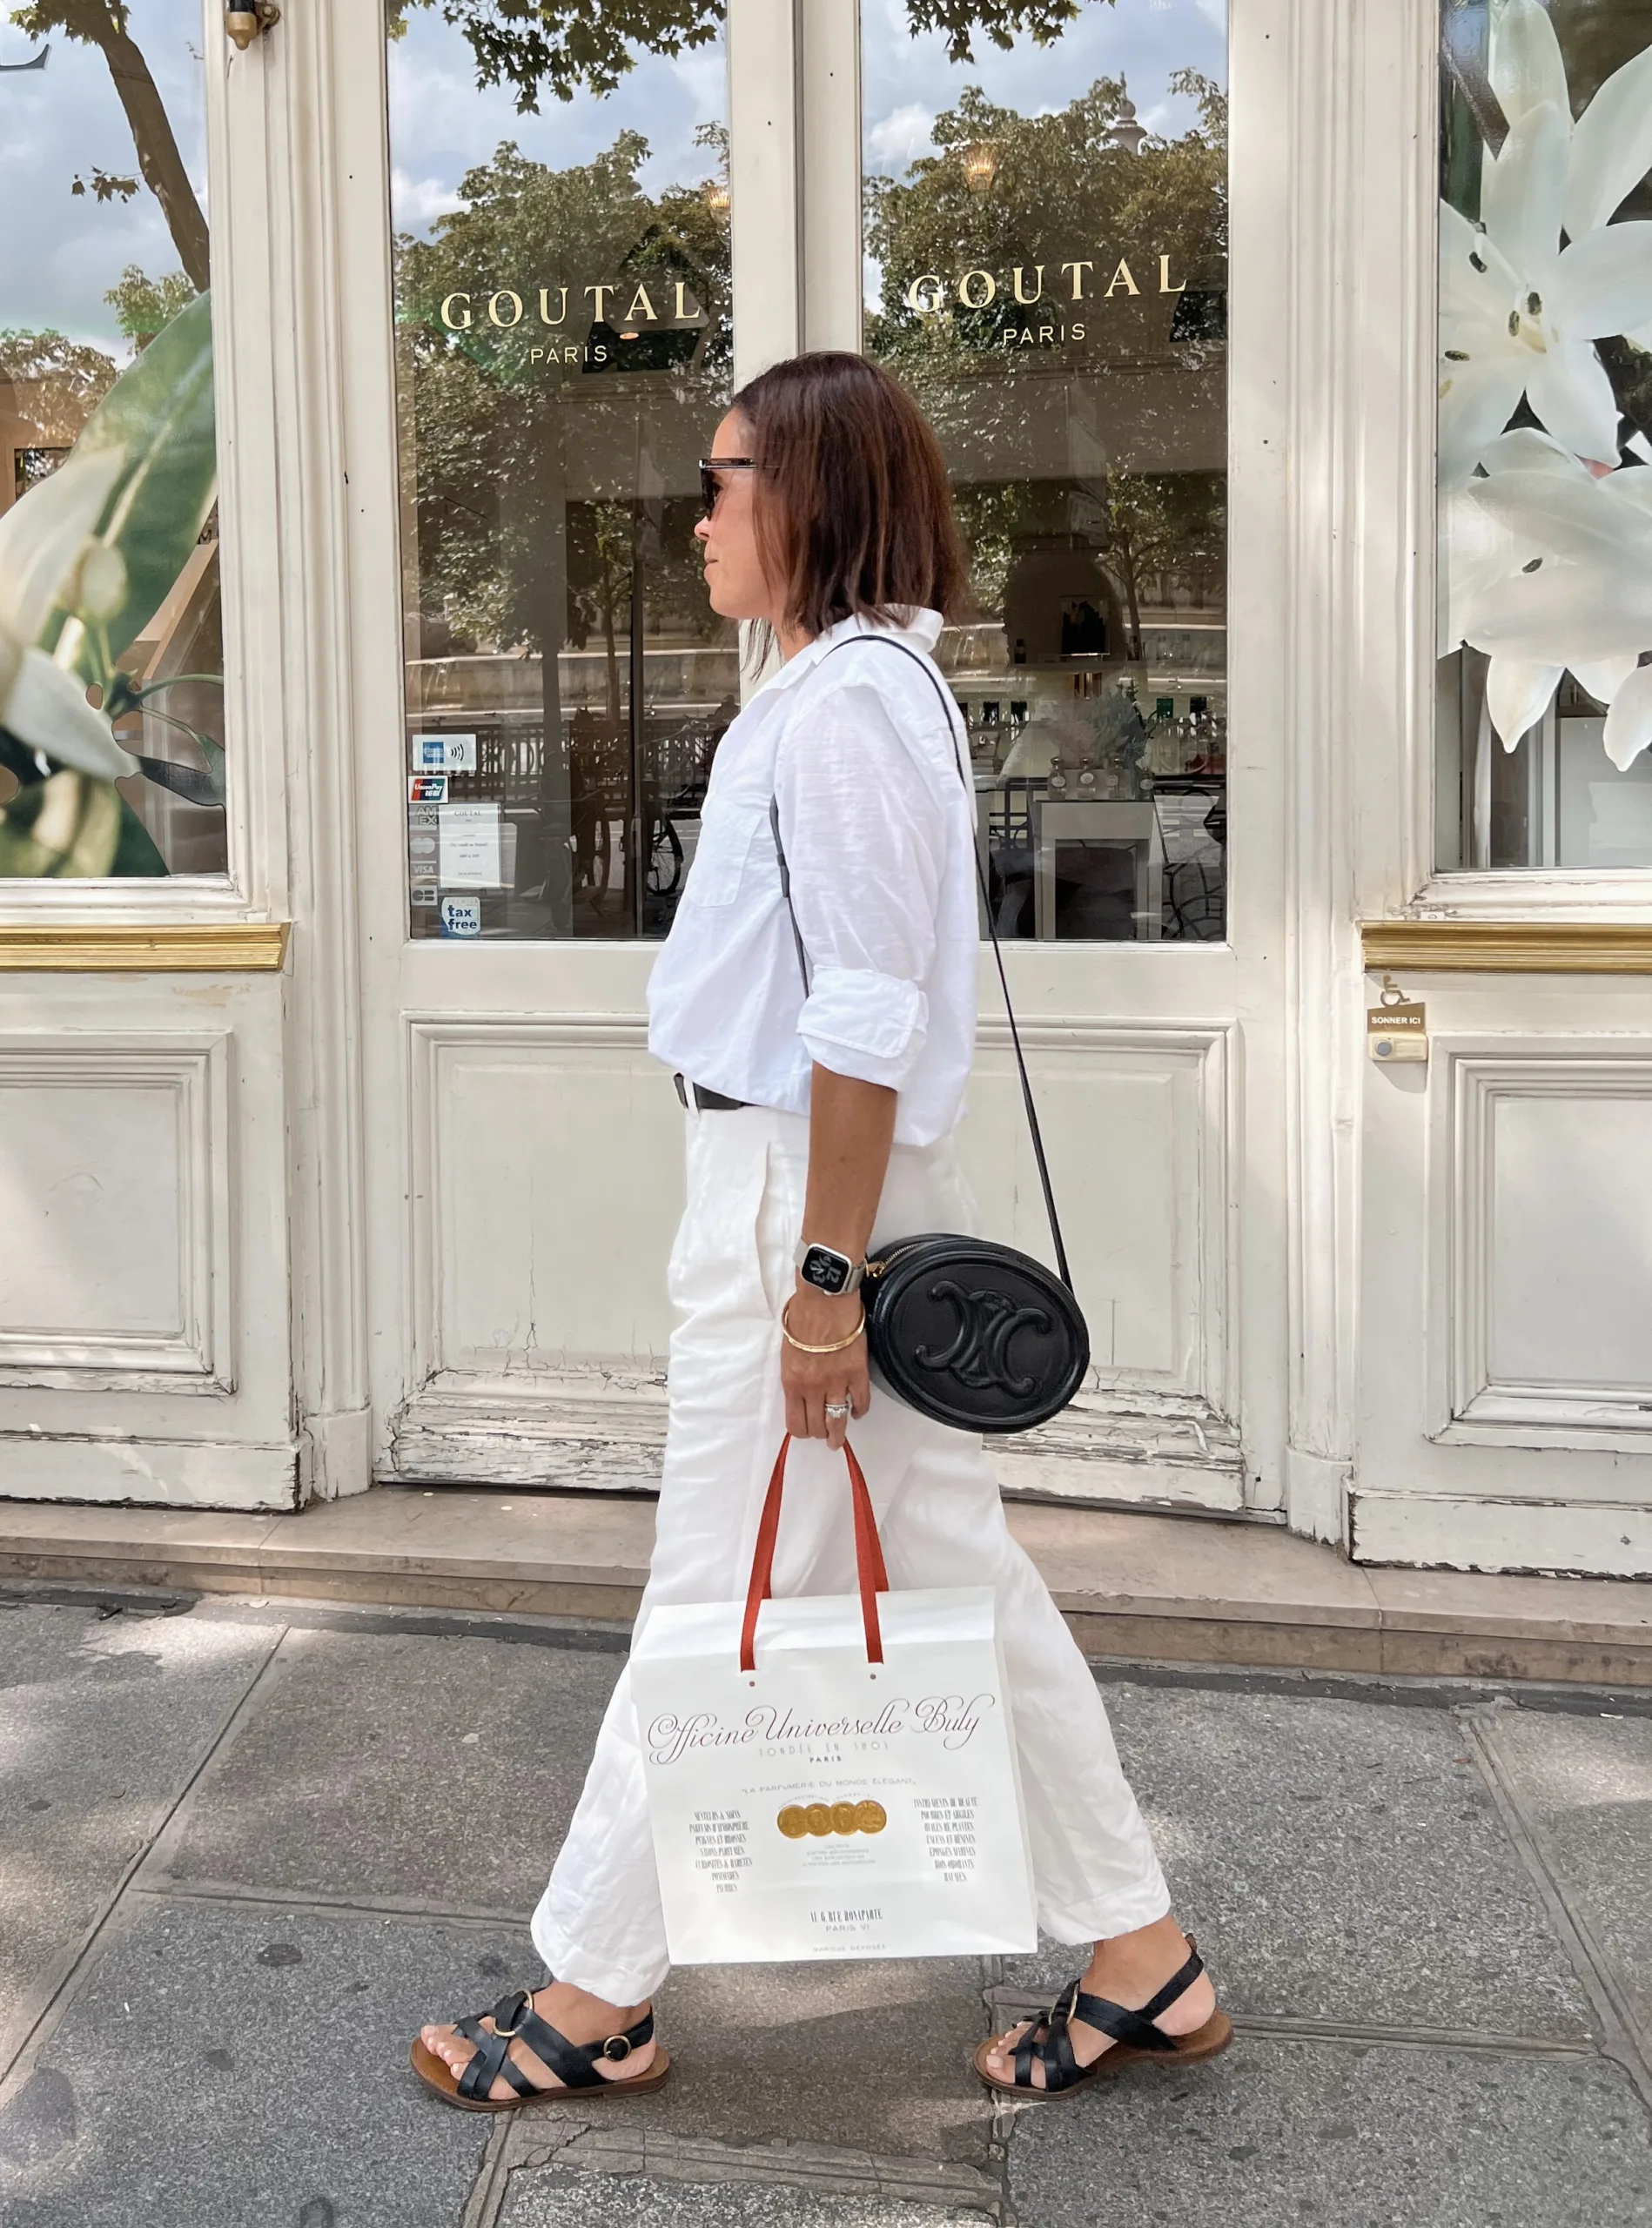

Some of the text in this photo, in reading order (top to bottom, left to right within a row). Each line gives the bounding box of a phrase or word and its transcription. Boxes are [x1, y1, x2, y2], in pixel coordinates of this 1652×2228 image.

[909, 254, 1187, 313] GOUTAL
[440, 282, 701, 330] GOUTAL
[1003, 323, 1086, 346] PARIS
[530, 345, 608, 365] PARIS
[447, 905, 472, 916] tax
[448, 919, 477, 930] free
[648, 1694, 995, 1764] Officine Universelle Buly
